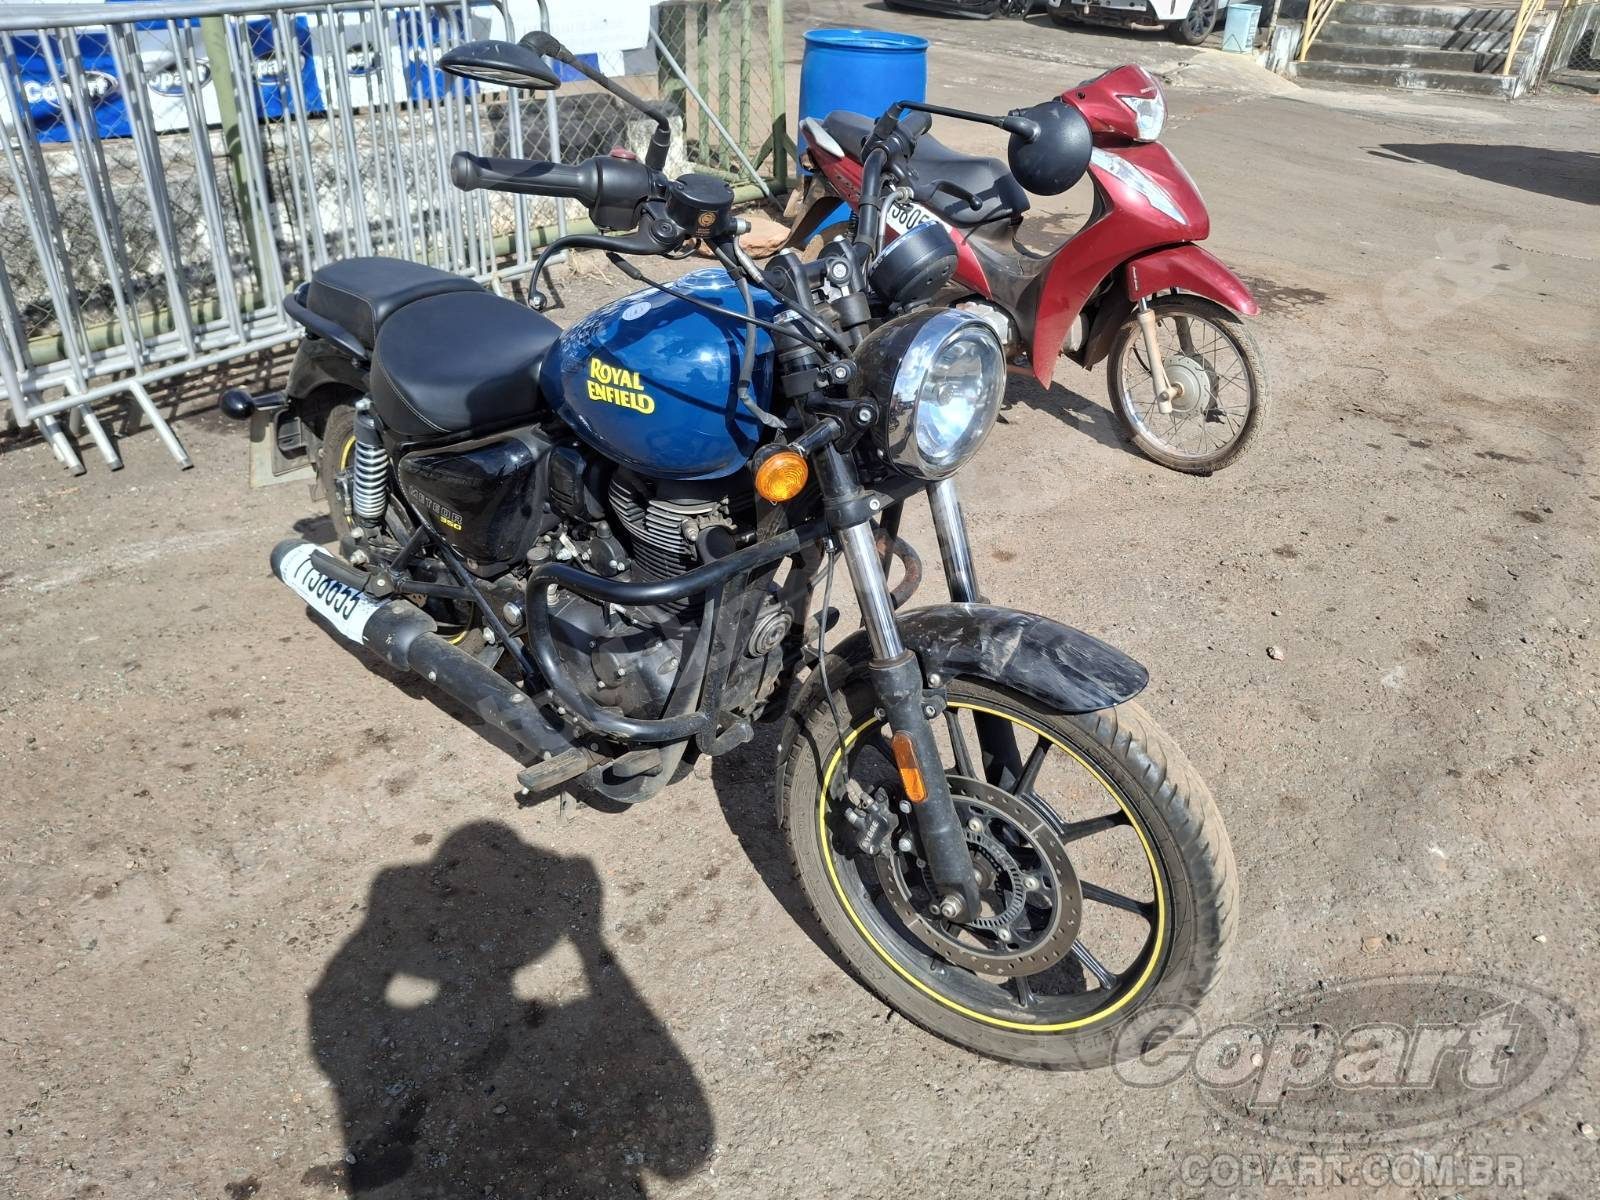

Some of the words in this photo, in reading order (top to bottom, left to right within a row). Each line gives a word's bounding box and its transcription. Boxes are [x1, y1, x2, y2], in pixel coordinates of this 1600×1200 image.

[590, 357, 645, 391] ROYAL
[587, 380, 655, 414] ENFIELD
[440, 516, 462, 531] 350
